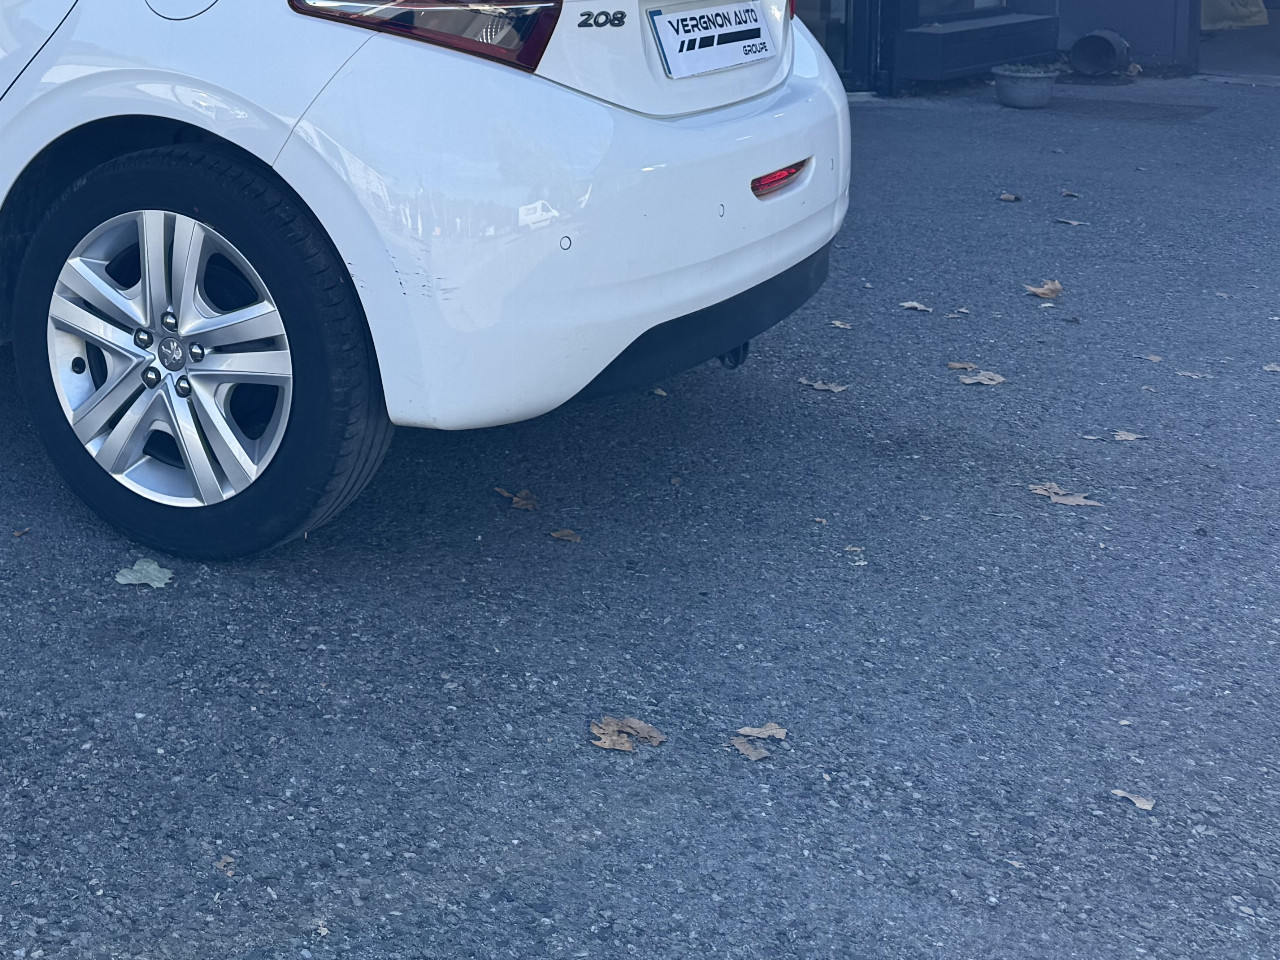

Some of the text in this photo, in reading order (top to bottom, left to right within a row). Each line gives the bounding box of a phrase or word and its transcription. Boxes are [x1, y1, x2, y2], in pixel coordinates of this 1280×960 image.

[577, 10, 627, 28] 208
[667, 8, 758, 36] VERGNON AUTO
[742, 41, 769, 56] GROUPE
